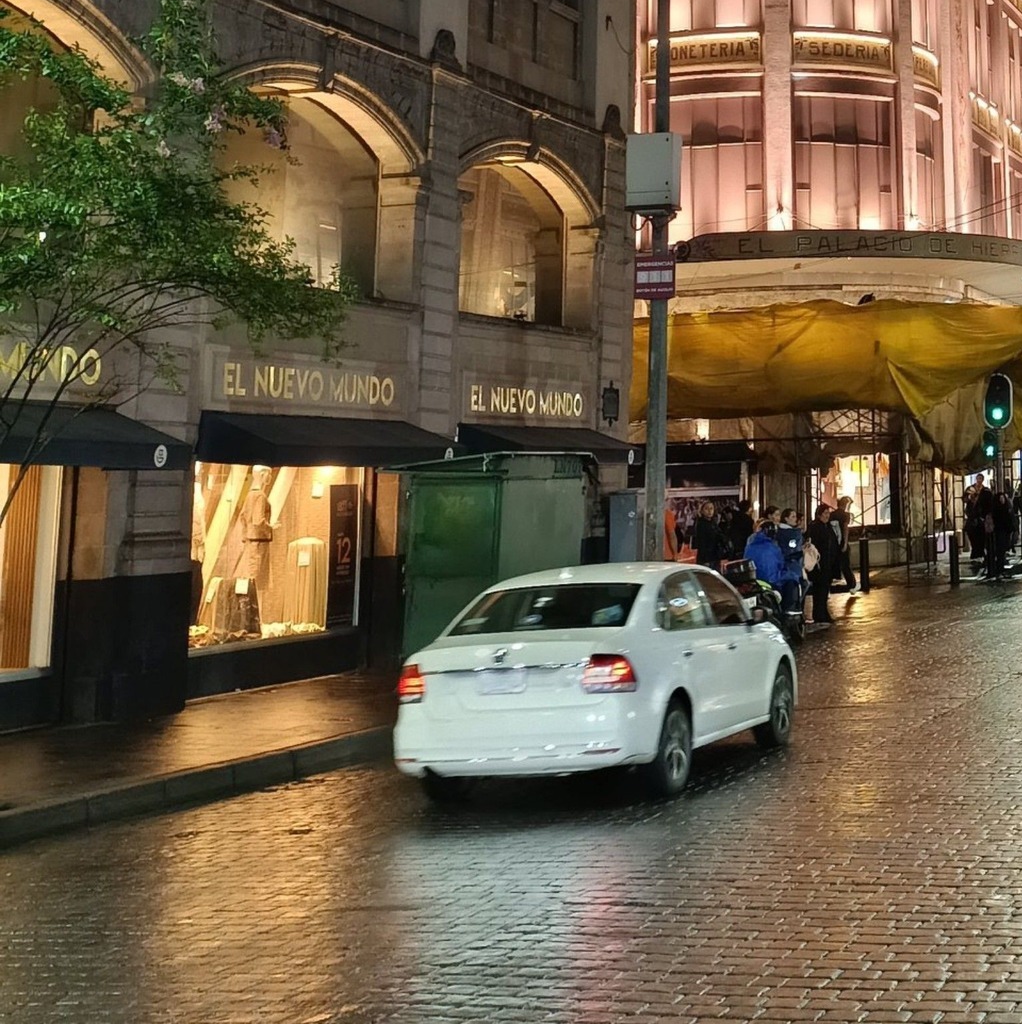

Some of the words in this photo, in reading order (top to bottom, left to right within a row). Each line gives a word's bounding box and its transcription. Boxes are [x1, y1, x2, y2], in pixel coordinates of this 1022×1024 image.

[668, 42, 745, 61] ONETERIA
[808, 42, 880, 60] SEDERIA
[738, 237, 774, 254] EL
[797, 236, 913, 255] PALACIO
[929, 237, 957, 254] DE
[223, 362, 247, 396] EL
[254, 365, 324, 401] NUEVO
[329, 373, 394, 406] MUNDO
[471, 385, 486, 412] EL
[490, 386, 536, 414] NUEVO
[539, 393, 583, 416] MUNDO
[336, 537, 351, 564] 12
